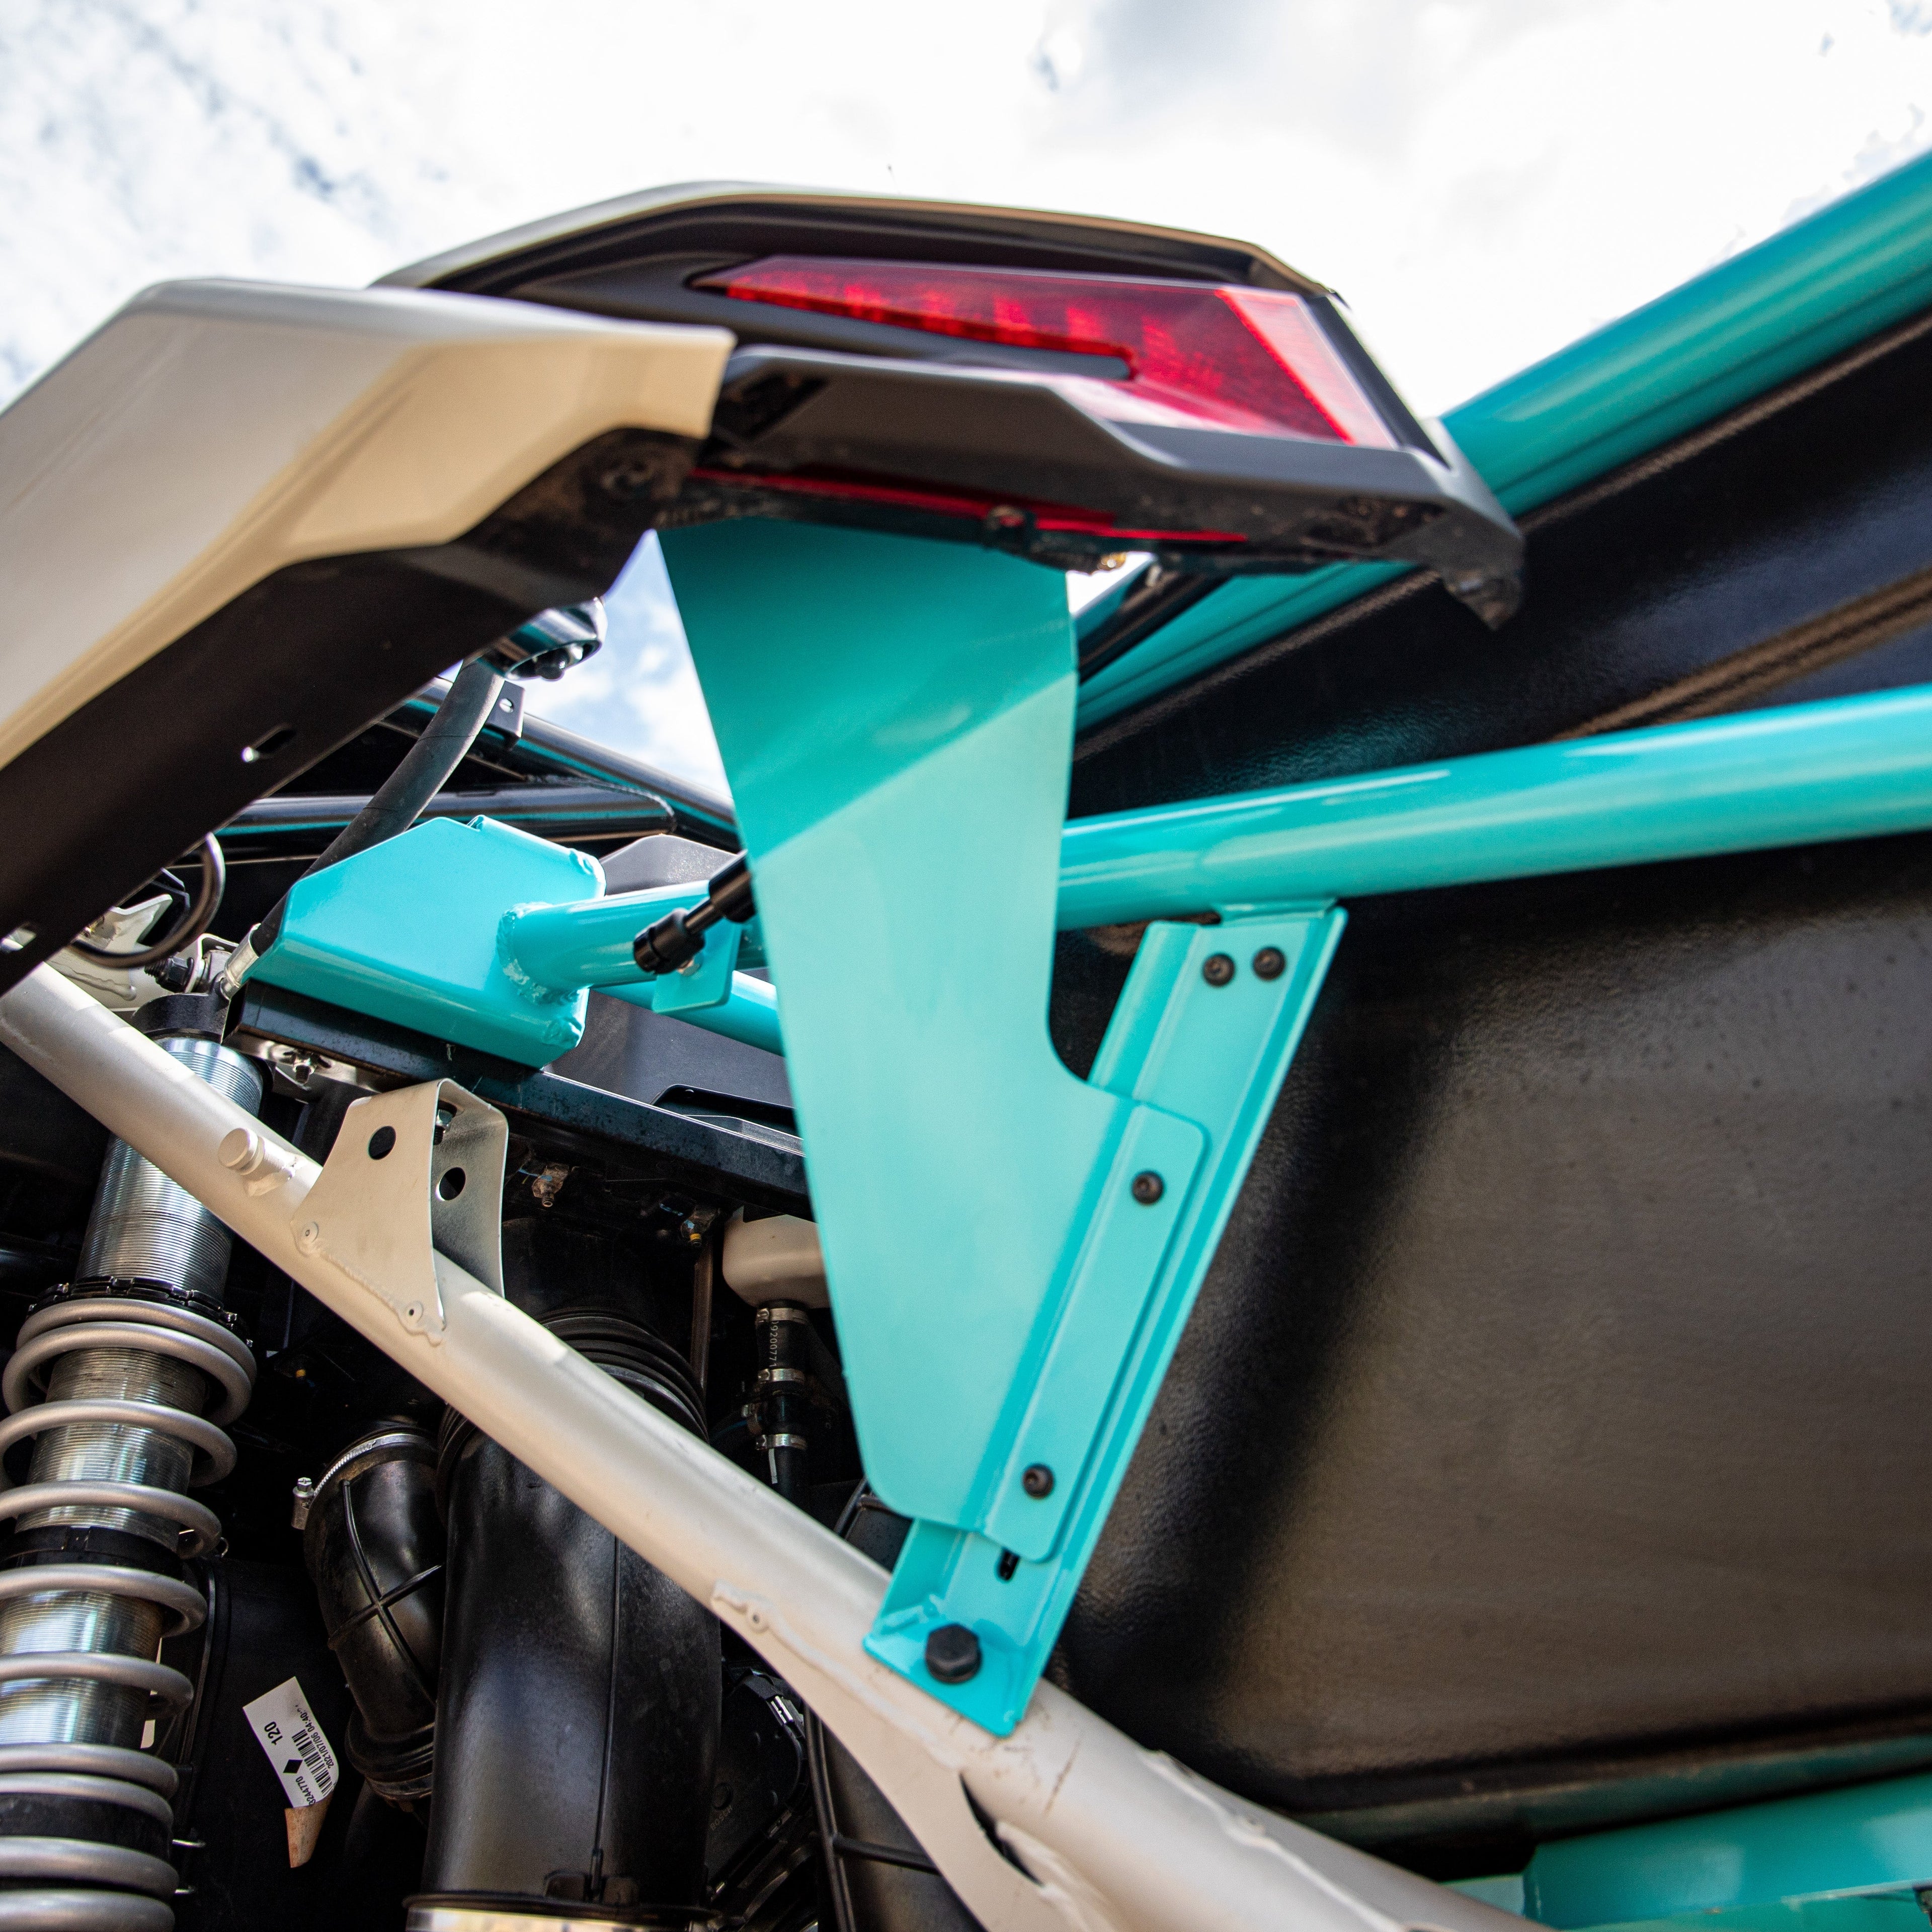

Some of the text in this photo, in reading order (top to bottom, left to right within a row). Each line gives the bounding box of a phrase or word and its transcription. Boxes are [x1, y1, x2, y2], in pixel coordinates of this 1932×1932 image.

[264, 1721, 283, 1745] 120
[311, 1732, 334, 1769] 2021/07/06
[710, 1804, 733, 1831] BOSCH
